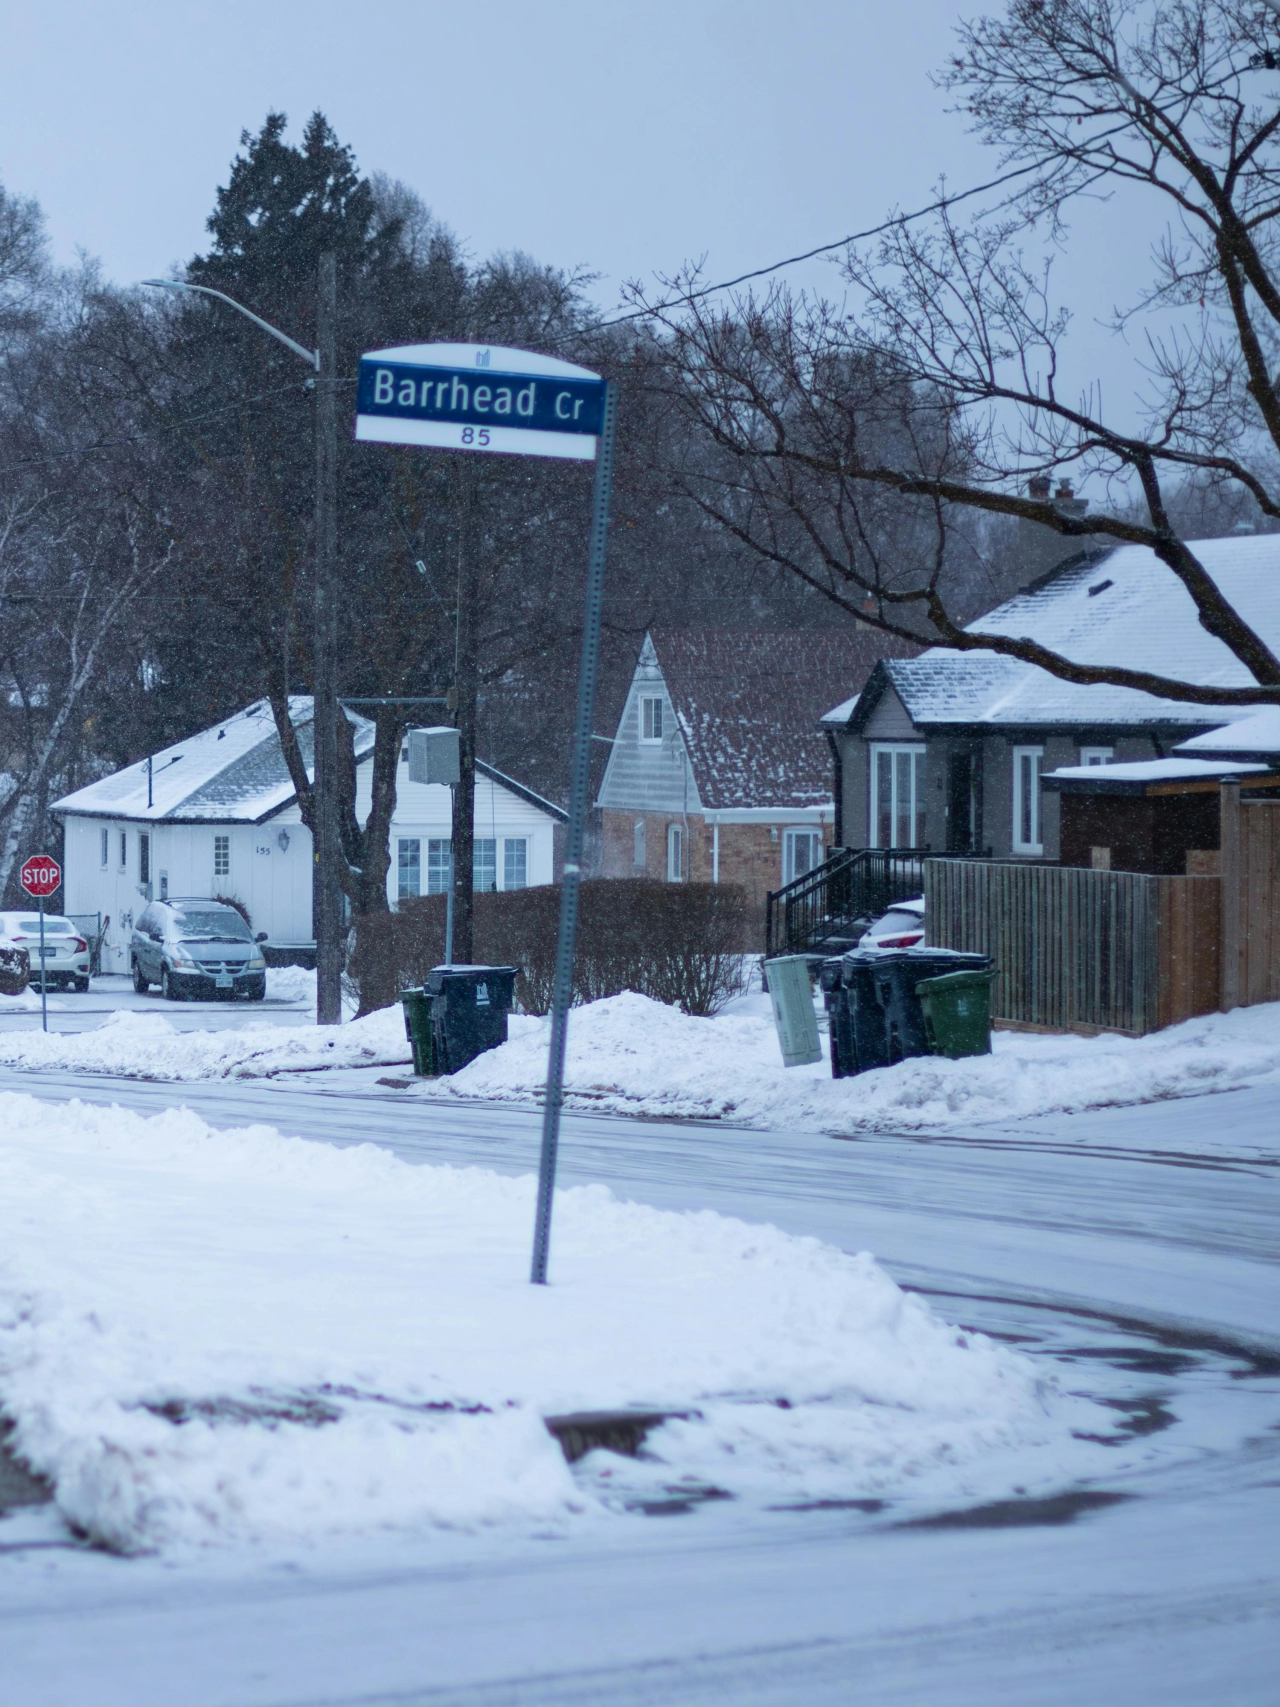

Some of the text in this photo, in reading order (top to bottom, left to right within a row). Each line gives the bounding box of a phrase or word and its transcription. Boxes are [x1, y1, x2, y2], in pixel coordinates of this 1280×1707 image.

[373, 369, 584, 420] Barrhead Cr
[460, 426, 491, 447] 85
[256, 845, 271, 856] 155
[23, 868, 58, 884] STOP
